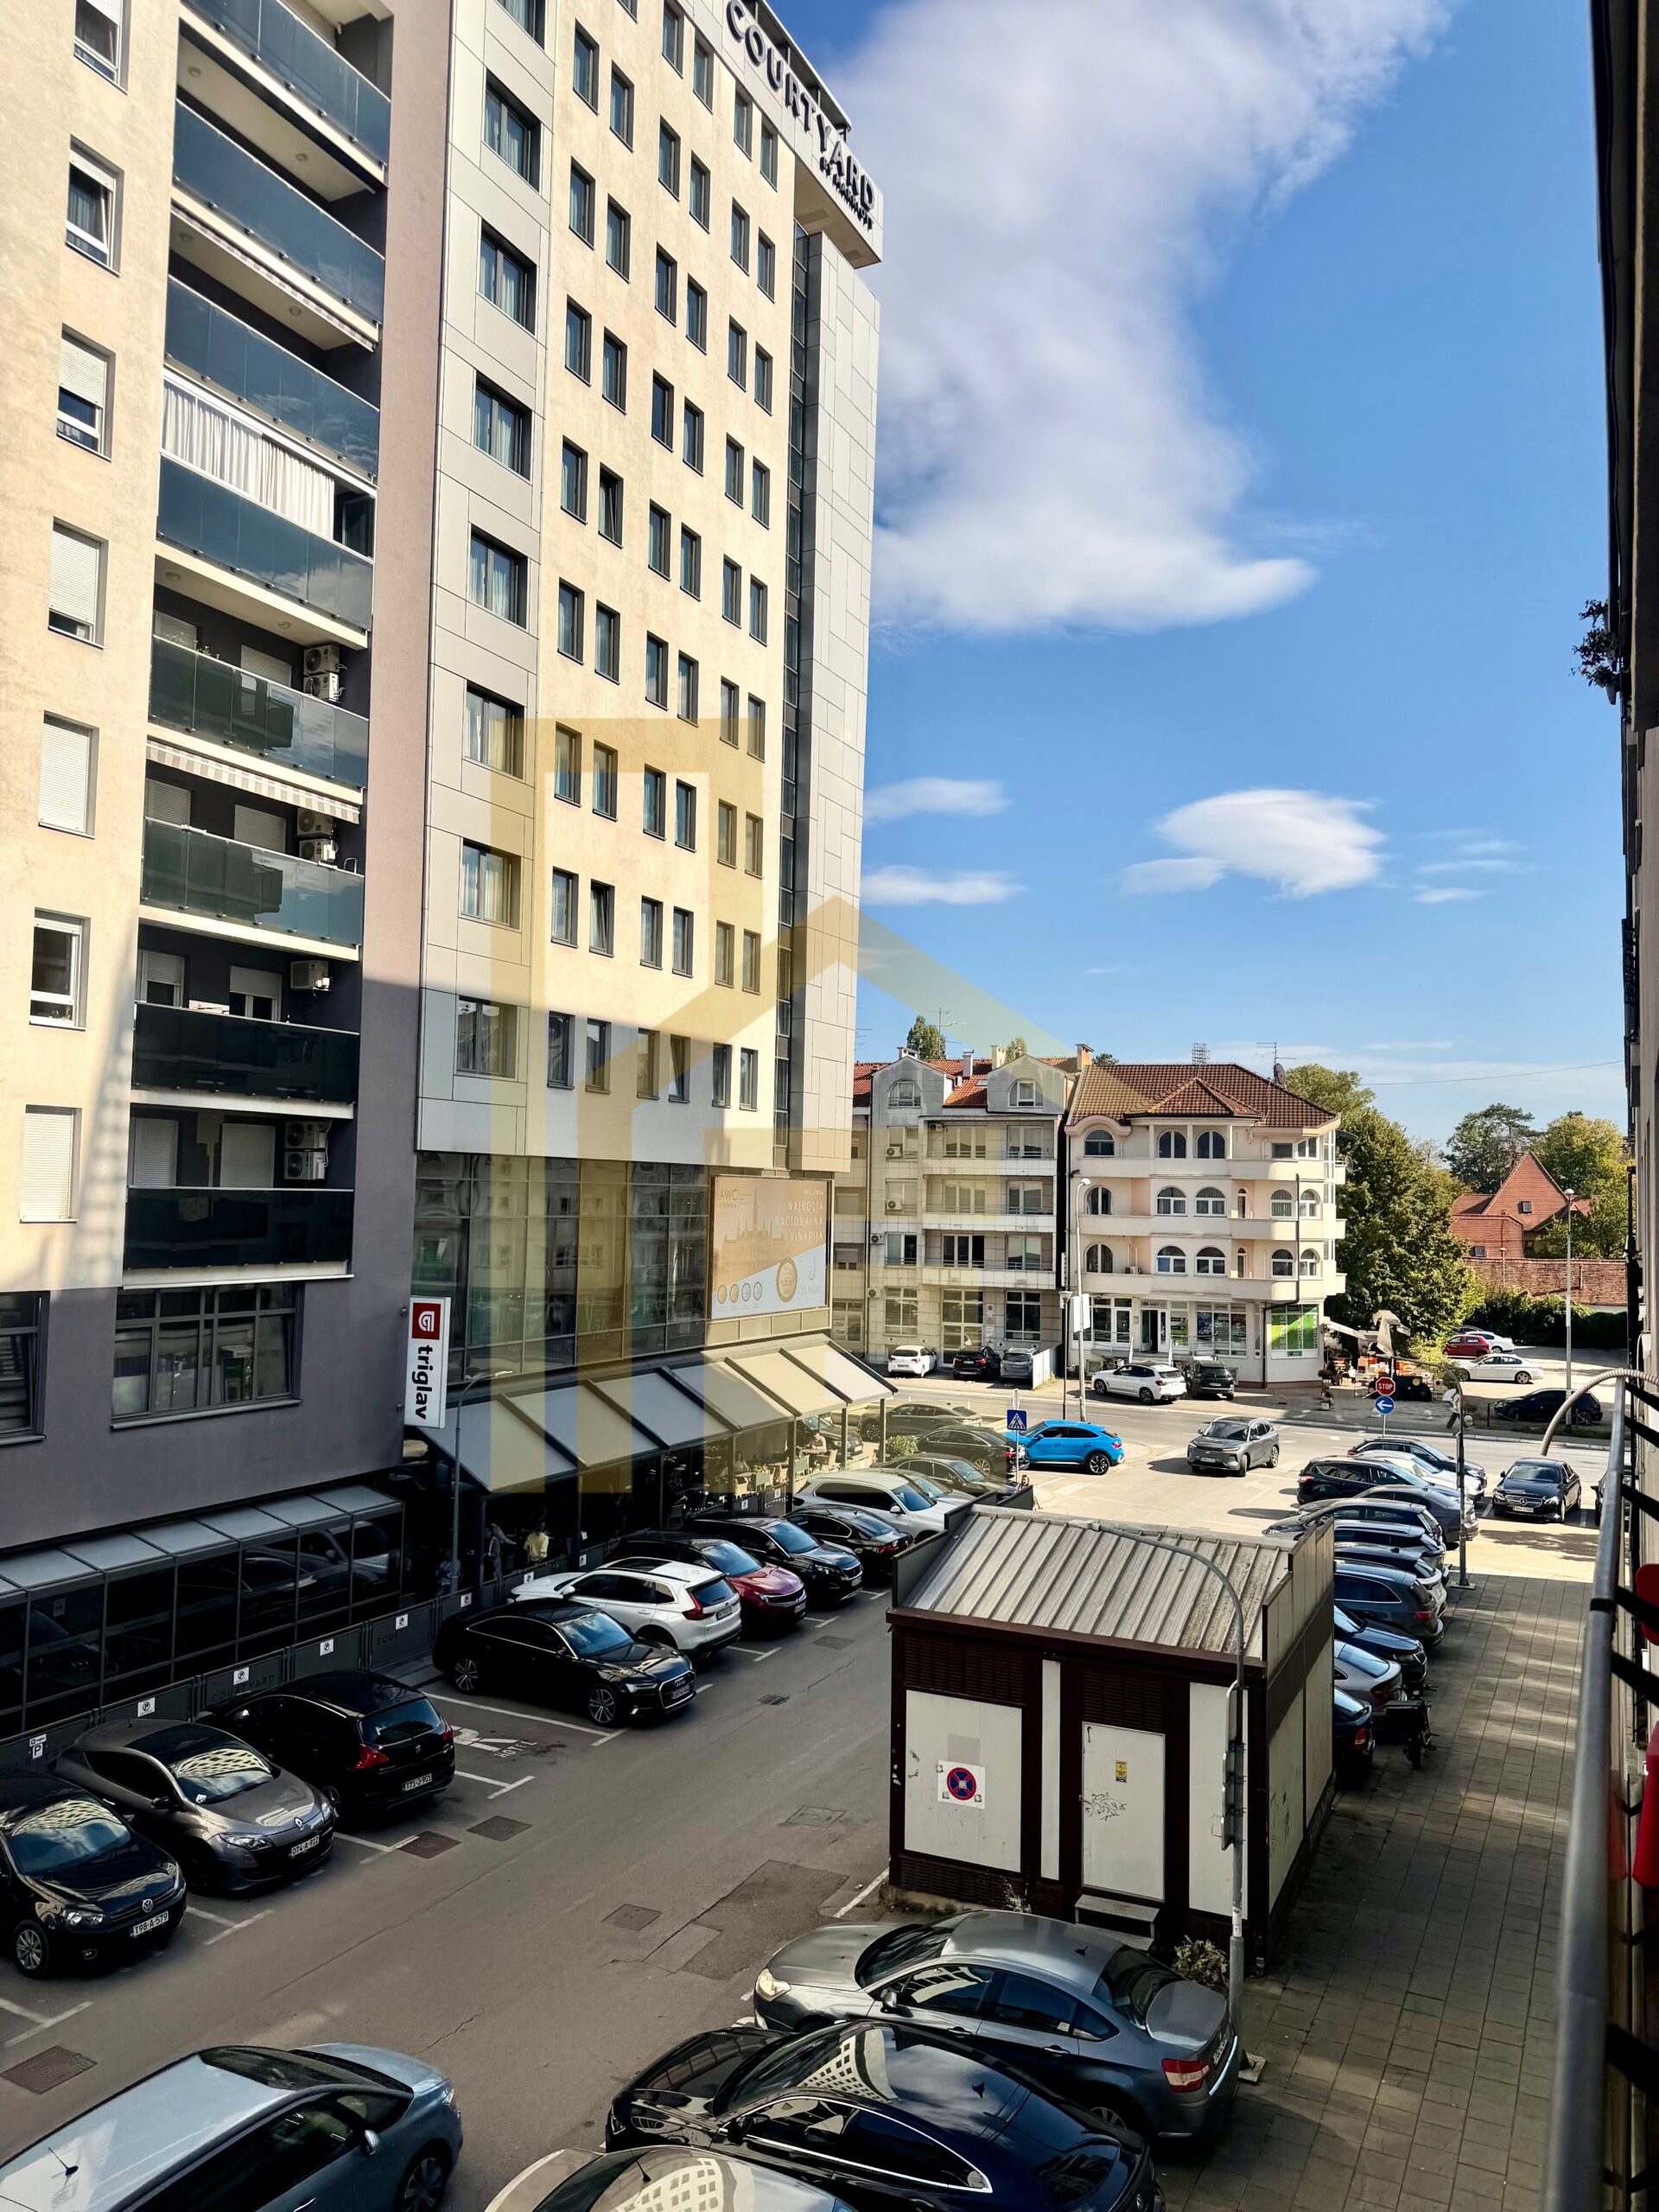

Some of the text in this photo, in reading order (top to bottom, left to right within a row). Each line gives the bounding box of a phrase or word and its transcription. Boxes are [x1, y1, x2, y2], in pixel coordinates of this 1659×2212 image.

[726, 0, 875, 213] COURTYARD
[719, 1189, 737, 1201] AWC
[788, 1200, 823, 1213] NAJBOLJA
[774, 1216, 823, 1226] NACIONALNA
[790, 1230, 823, 1243] VINARIJA
[411, 1344, 434, 1420] triglav
[34, 1745, 41, 1756] P
[493, 1740, 537, 1758] HOTEL
[134, 1912, 168, 1935] T98-A-579
